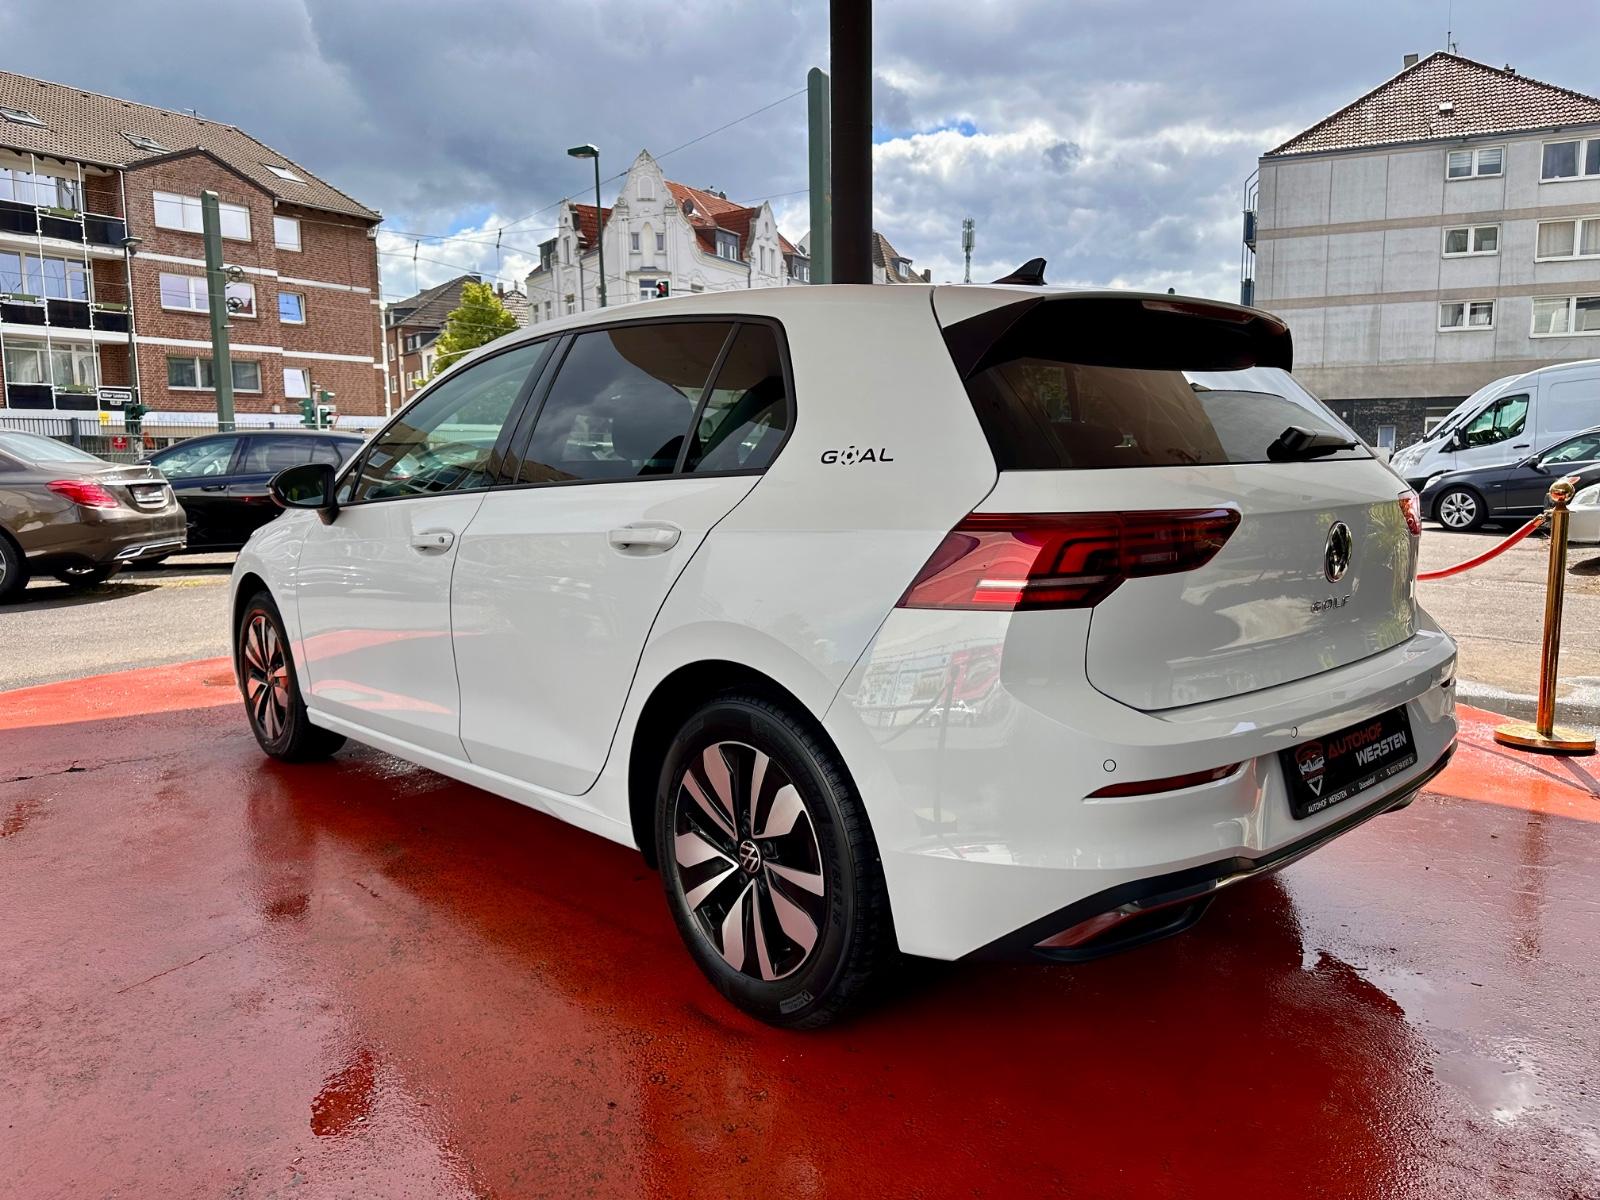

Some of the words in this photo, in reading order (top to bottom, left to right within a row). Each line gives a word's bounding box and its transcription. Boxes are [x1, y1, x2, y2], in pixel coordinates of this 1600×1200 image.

[820, 445, 894, 465] GOAL
[1311, 594, 1350, 613] GOLF
[1328, 722, 1383, 759] AUTOHOF
[1355, 730, 1407, 766] WERSTEN
